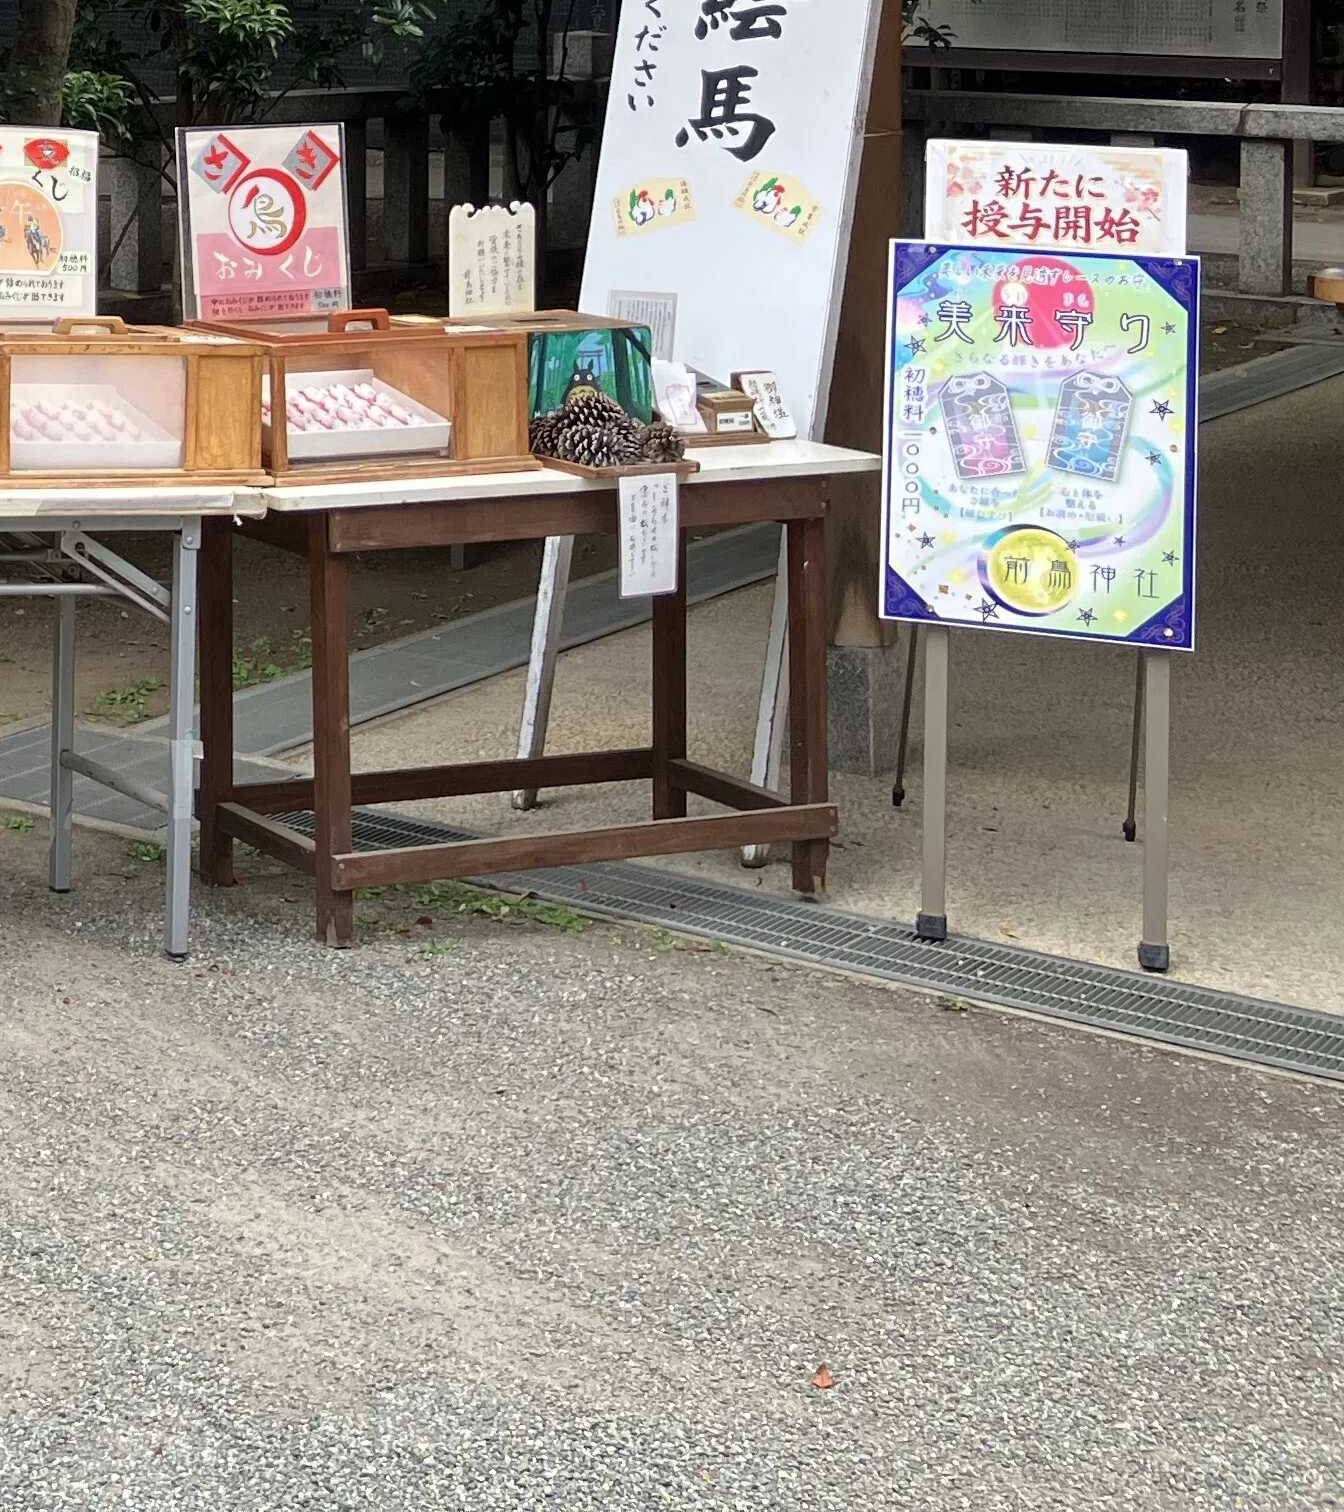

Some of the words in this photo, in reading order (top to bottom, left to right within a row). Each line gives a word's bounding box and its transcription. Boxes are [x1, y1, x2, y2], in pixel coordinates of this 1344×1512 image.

[995, 165, 1105, 199] 新たに
[962, 199, 1142, 245] 授与開始
[213, 246, 323, 281] おみくじ
[935, 299, 1150, 354] 美来守り
[904, 367, 926, 421] 初穂料
[1003, 554, 1159, 600] 前鳥神社
